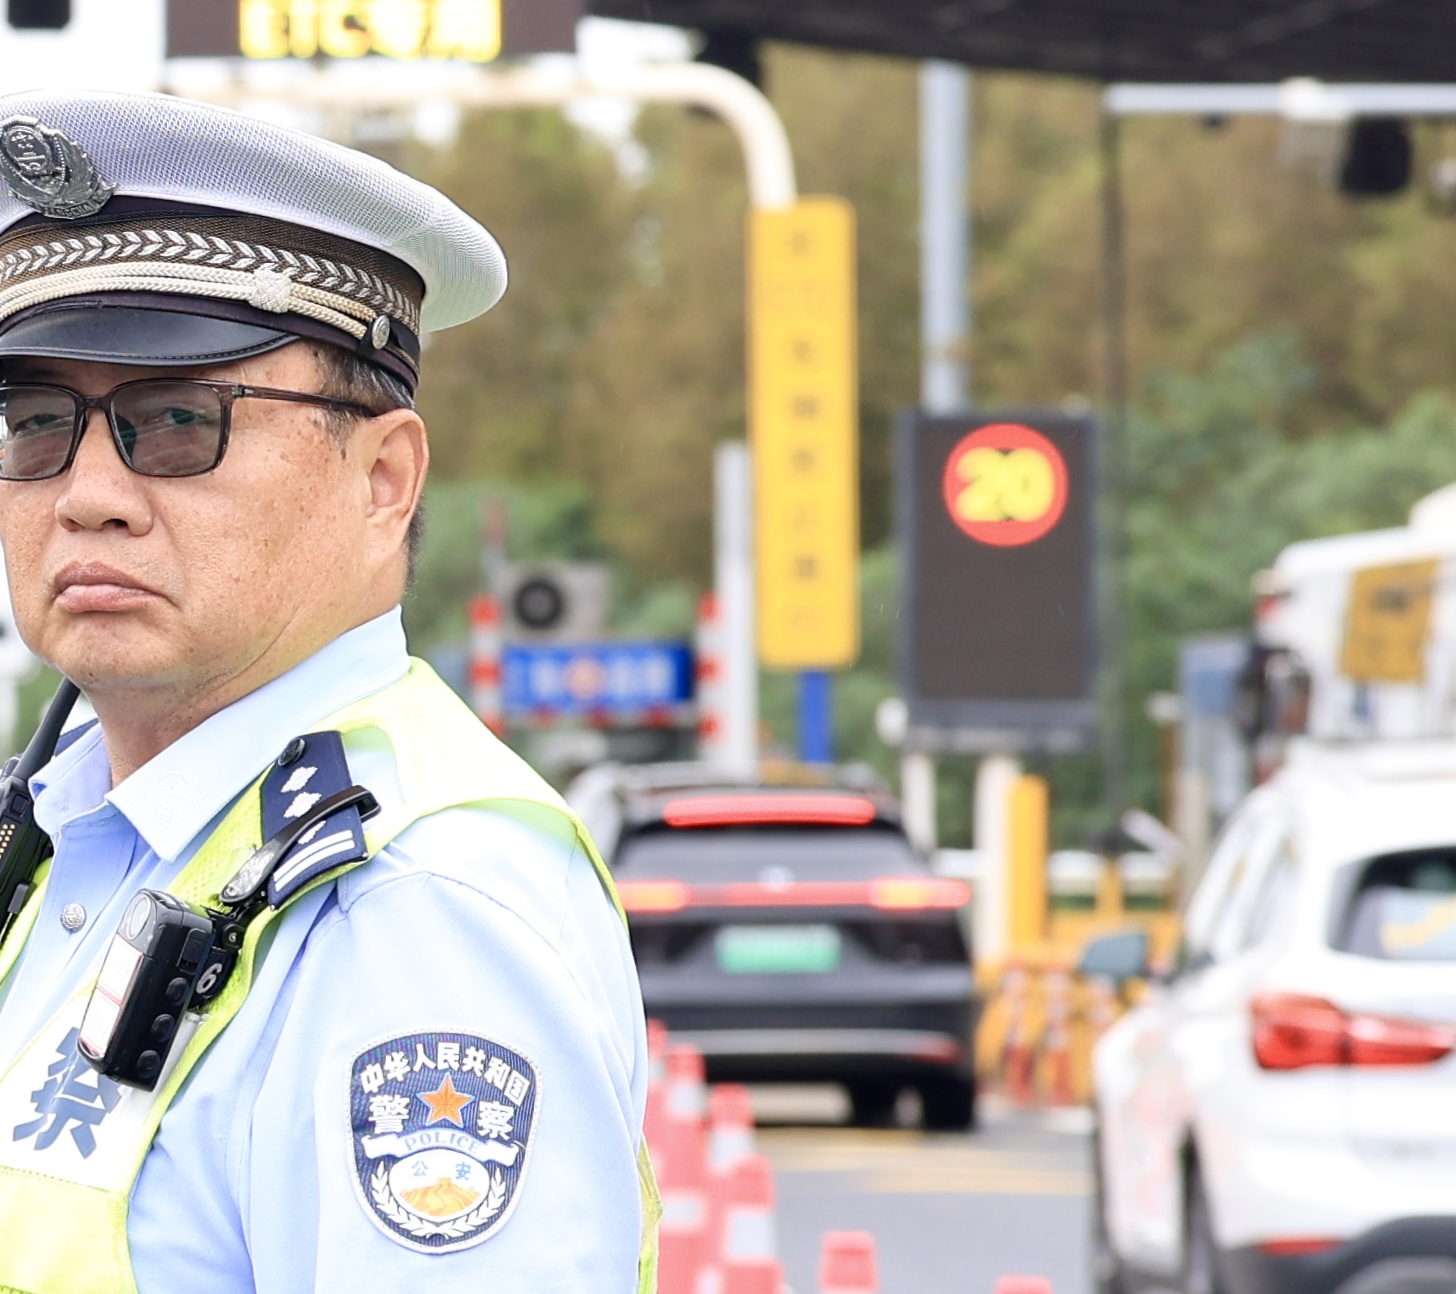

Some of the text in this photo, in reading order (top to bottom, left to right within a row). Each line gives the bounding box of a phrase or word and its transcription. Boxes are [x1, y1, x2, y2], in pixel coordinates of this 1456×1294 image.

[955, 446, 1055, 523] 20
[360, 1042, 530, 1106] 中华人民共和国
[403, 1131, 482, 1154] POLICE
[411, 1160, 471, 1180] 公安
